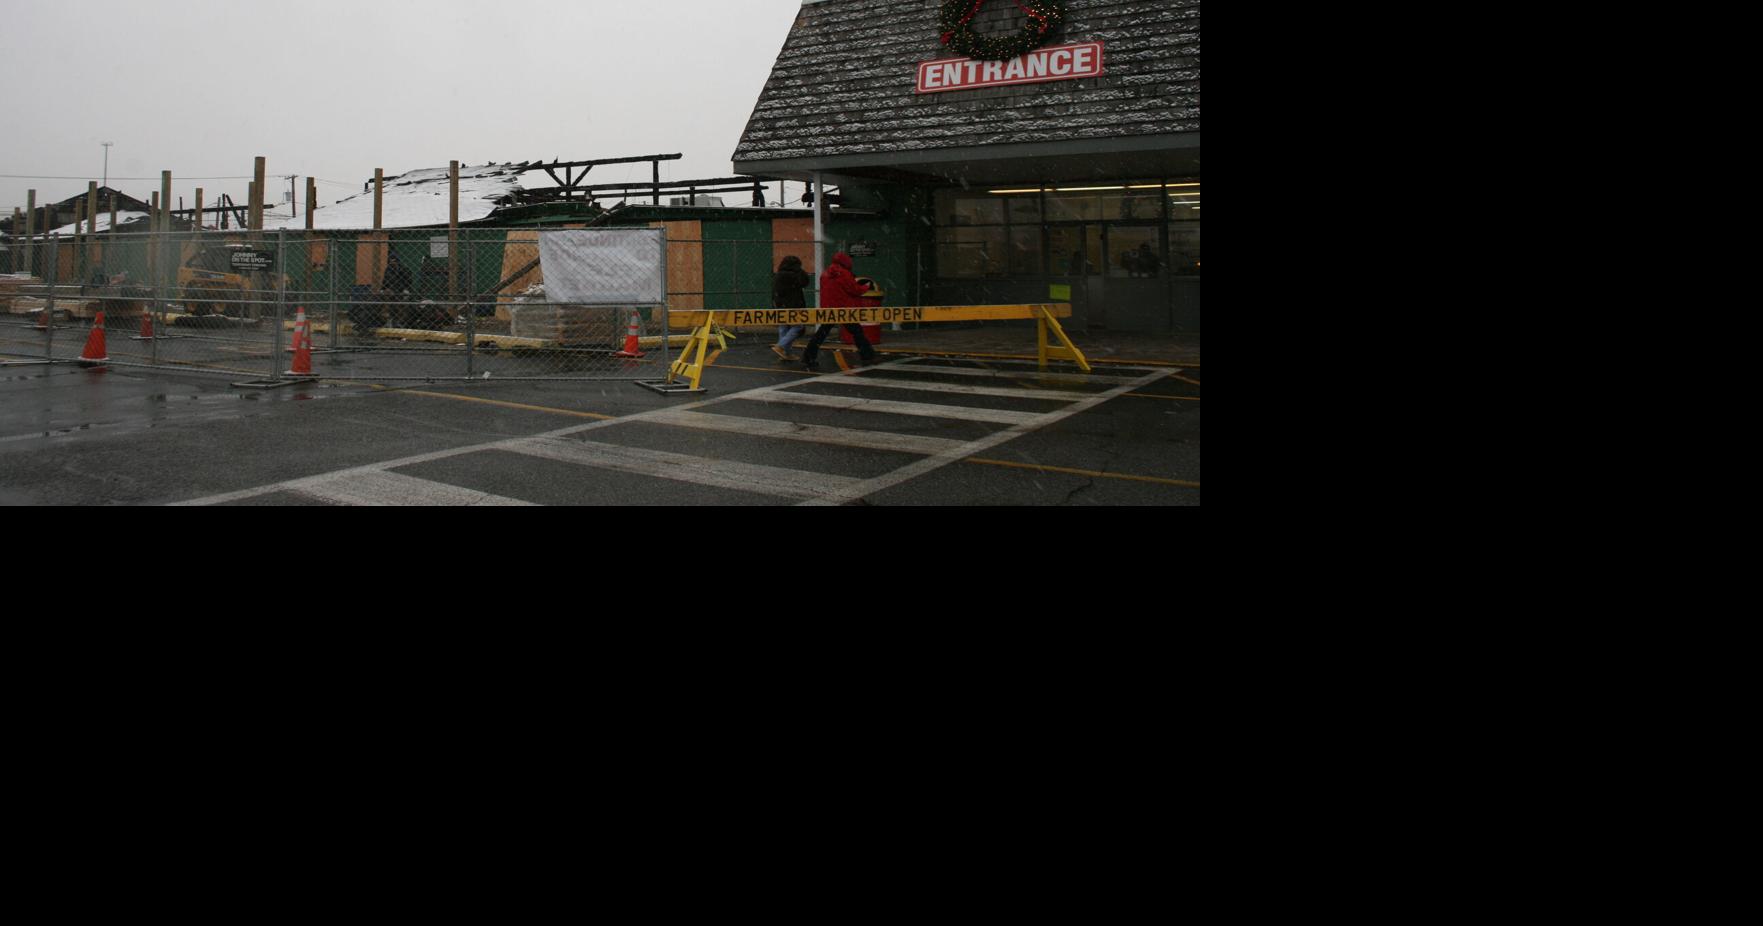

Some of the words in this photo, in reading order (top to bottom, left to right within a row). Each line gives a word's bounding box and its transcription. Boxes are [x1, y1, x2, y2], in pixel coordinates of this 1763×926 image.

[925, 48, 1092, 88] ENTRANCE
[816, 309, 878, 322] MARKET
[883, 308, 922, 320] OPEN
